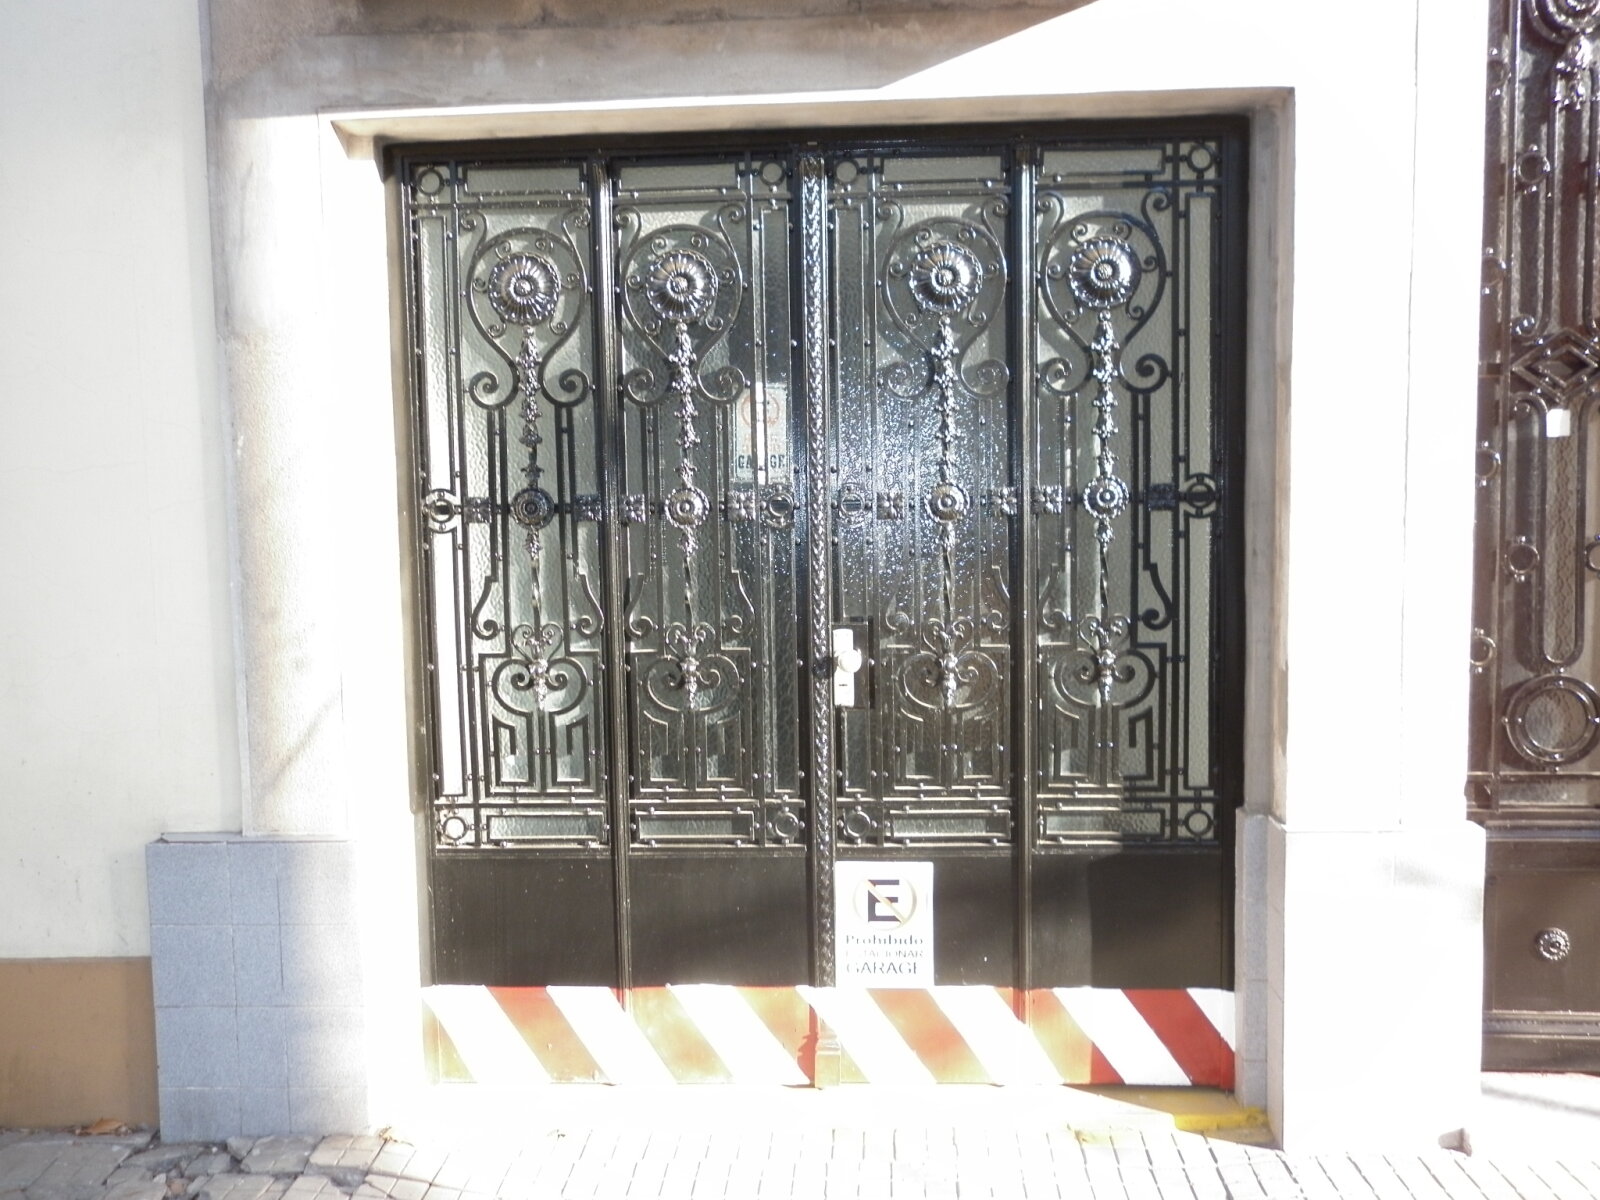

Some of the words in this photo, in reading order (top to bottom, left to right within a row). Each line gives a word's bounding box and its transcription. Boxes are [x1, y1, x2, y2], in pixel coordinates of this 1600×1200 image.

[738, 455, 785, 469] GAGE
[867, 879, 902, 922] E
[846, 934, 924, 945] Prohibido
[846, 949, 924, 958] TACIONAR
